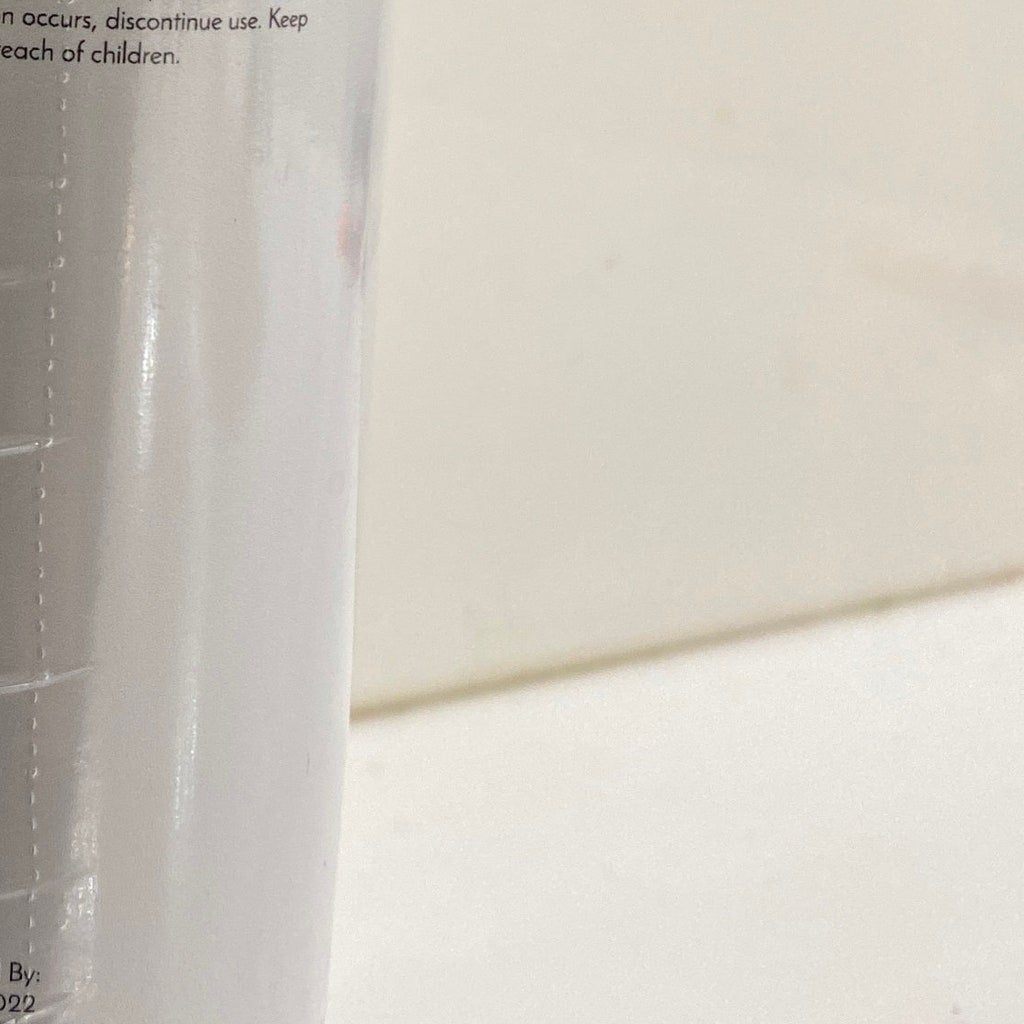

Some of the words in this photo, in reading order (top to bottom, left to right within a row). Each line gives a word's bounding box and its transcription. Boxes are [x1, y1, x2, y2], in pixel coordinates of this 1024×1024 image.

[22, 10, 97, 32] occurs,
[106, 7, 222, 32] discontinue
[228, 13, 262, 31] use.
[269, 8, 309, 33] Keep
[62, 40, 85, 63] of
[91, 40, 180, 66] children.
[9, 961, 41, 987] By:
